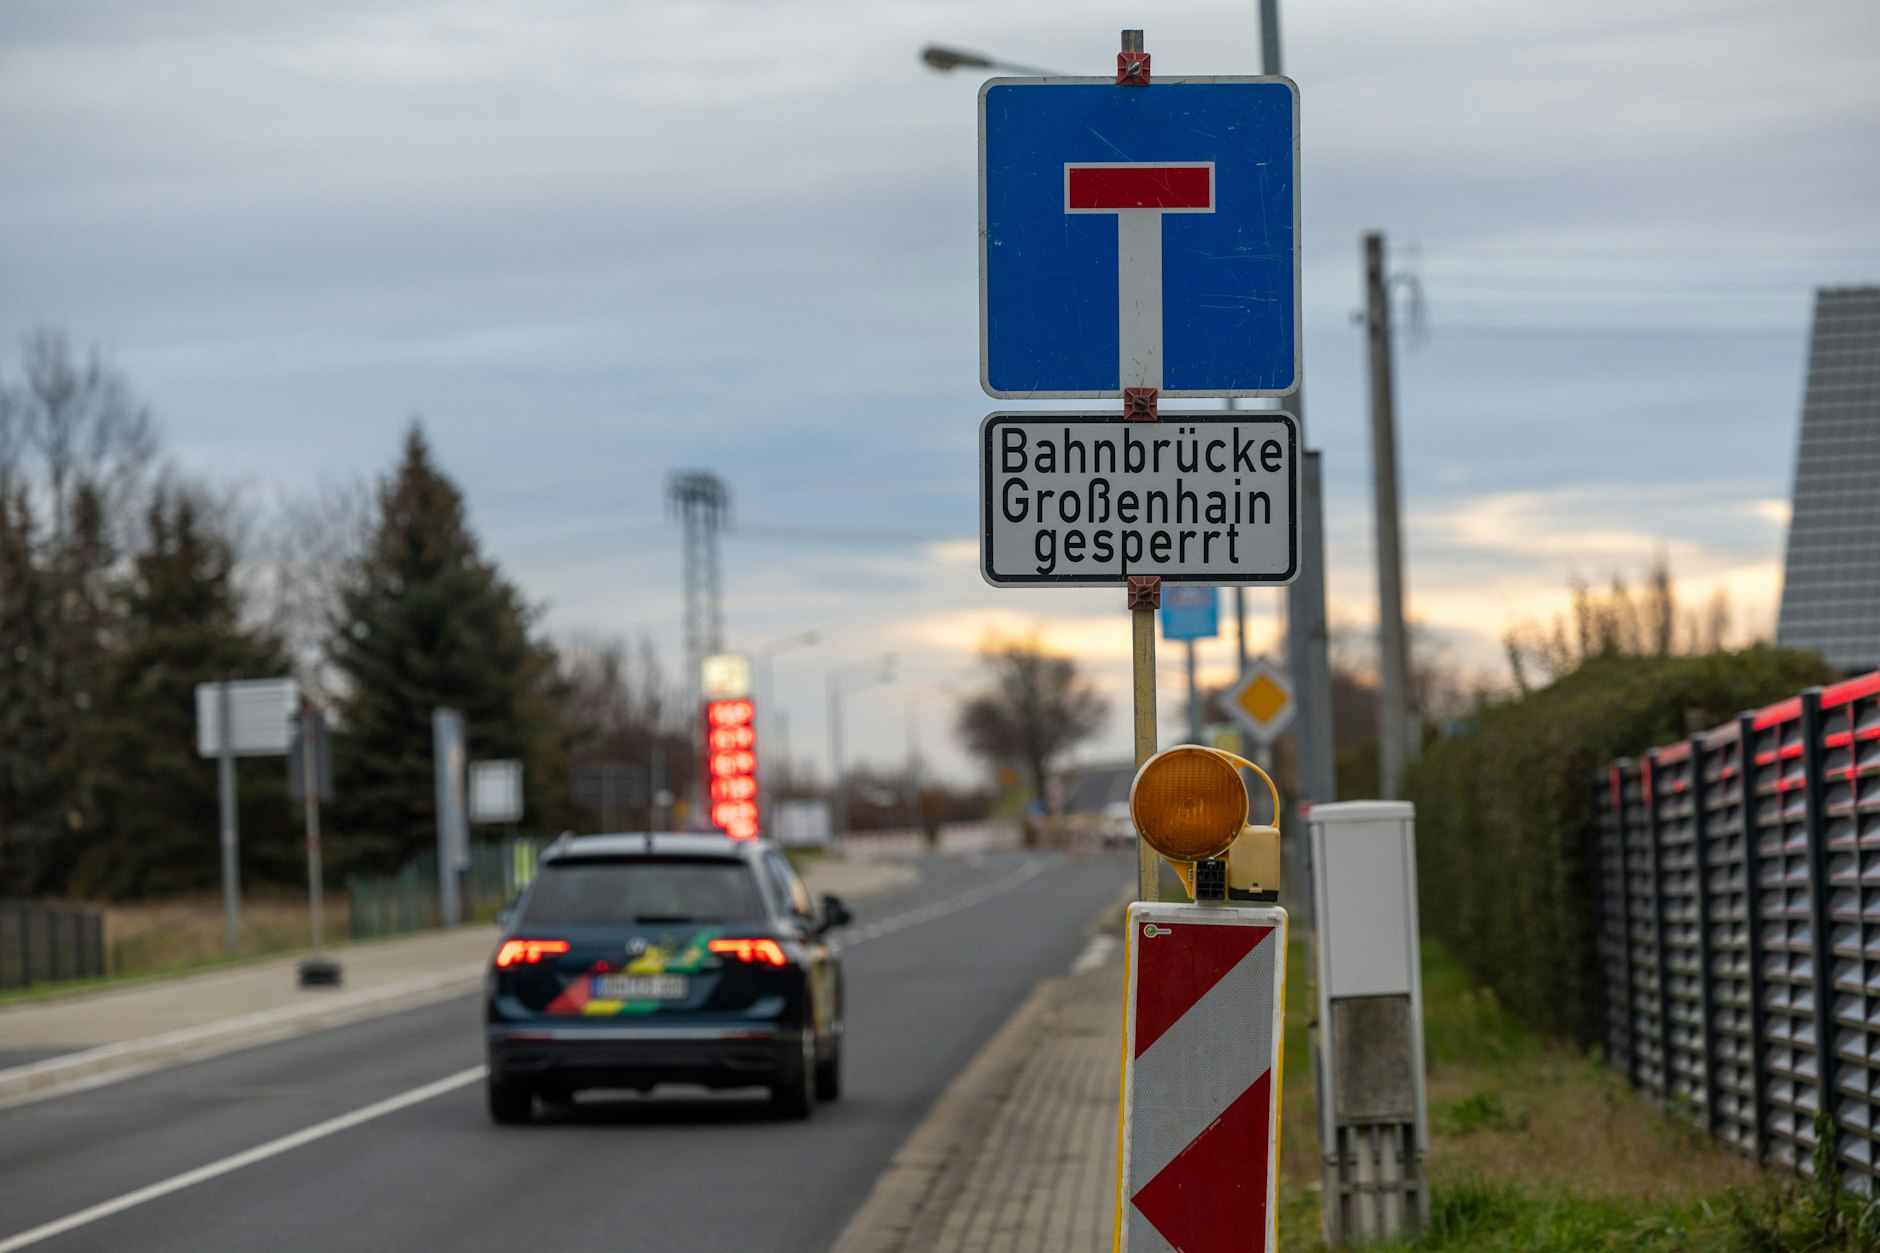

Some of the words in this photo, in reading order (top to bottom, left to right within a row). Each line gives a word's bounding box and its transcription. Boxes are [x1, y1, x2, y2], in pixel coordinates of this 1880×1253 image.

[1001, 427, 1282, 473] Bahnbrücke
[1002, 477, 1271, 524] Großenhain
[1035, 523, 1239, 575] gesperrt
